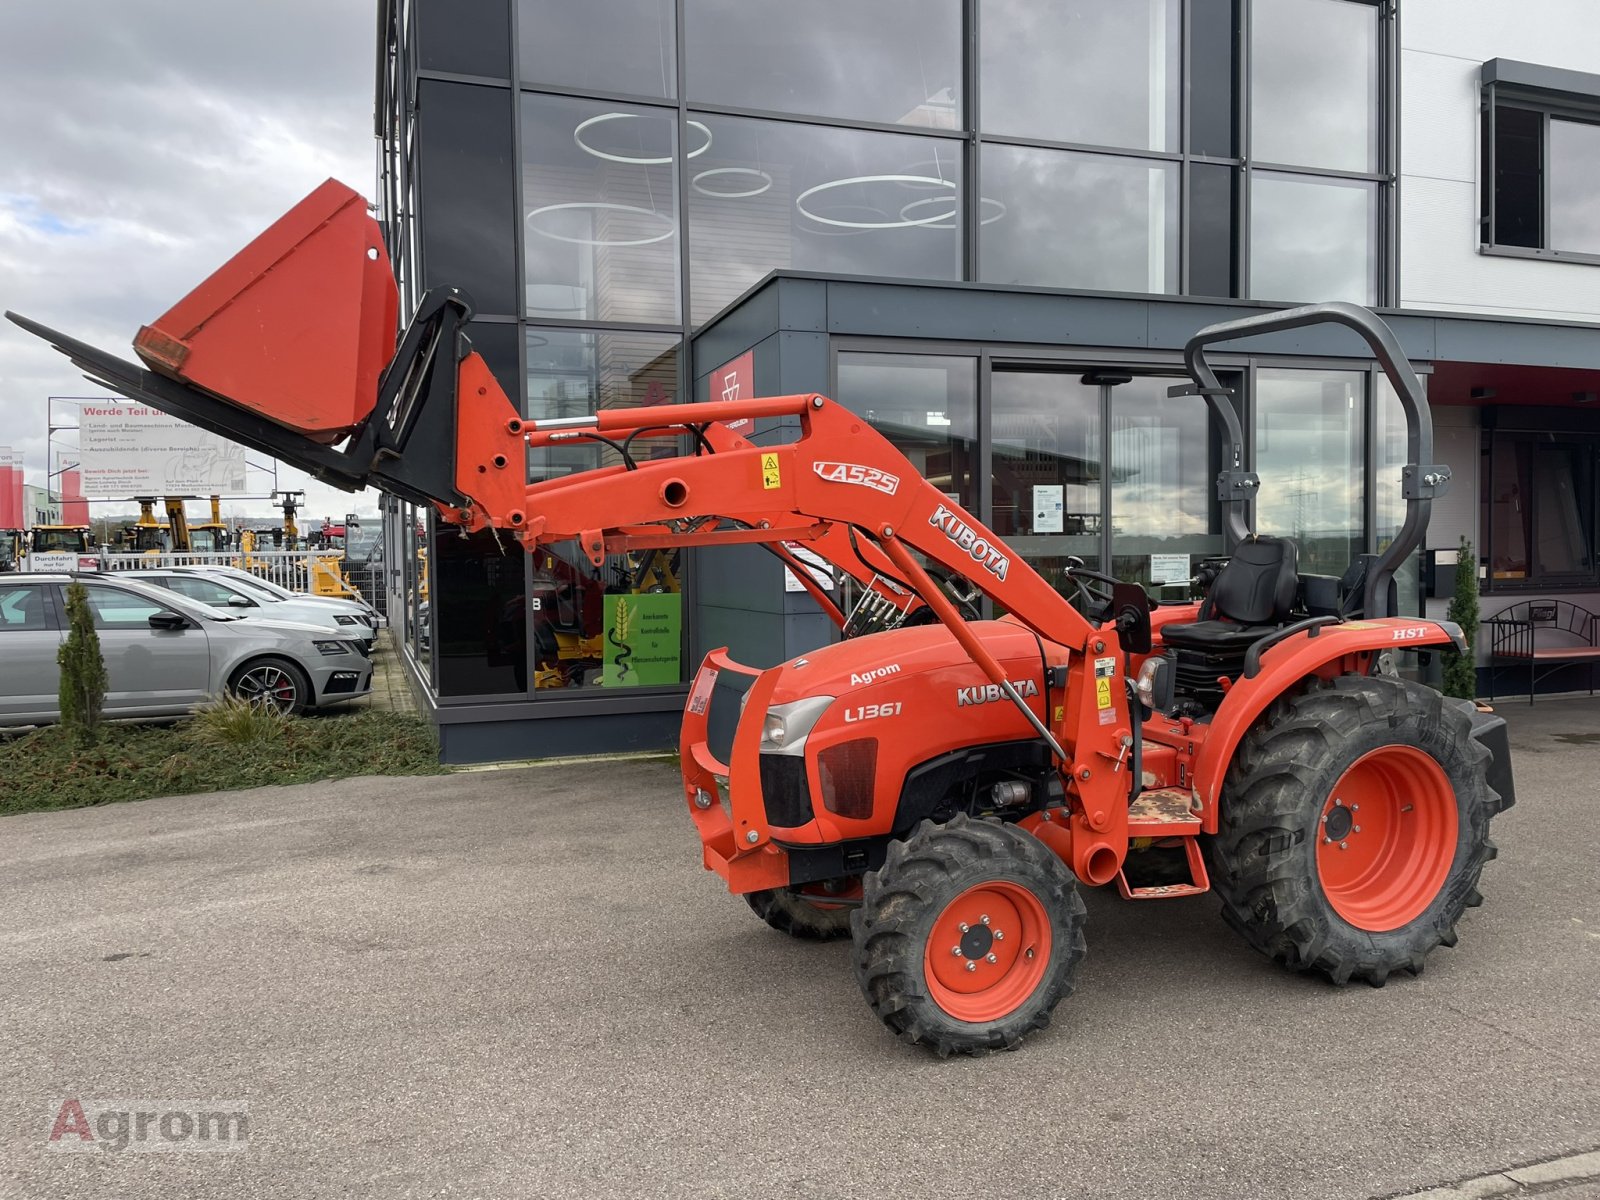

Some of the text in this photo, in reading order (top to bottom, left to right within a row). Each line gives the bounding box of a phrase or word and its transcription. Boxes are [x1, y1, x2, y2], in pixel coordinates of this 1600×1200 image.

[84, 407, 123, 416] Werde
[127, 407, 148, 416] Teil
[816, 463, 897, 493] LA525
[928, 504, 1010, 581] KUBOTA
[1392, 627, 1427, 640] HST
[850, 663, 901, 686] Agrom
[844, 702, 902, 723] L1361
